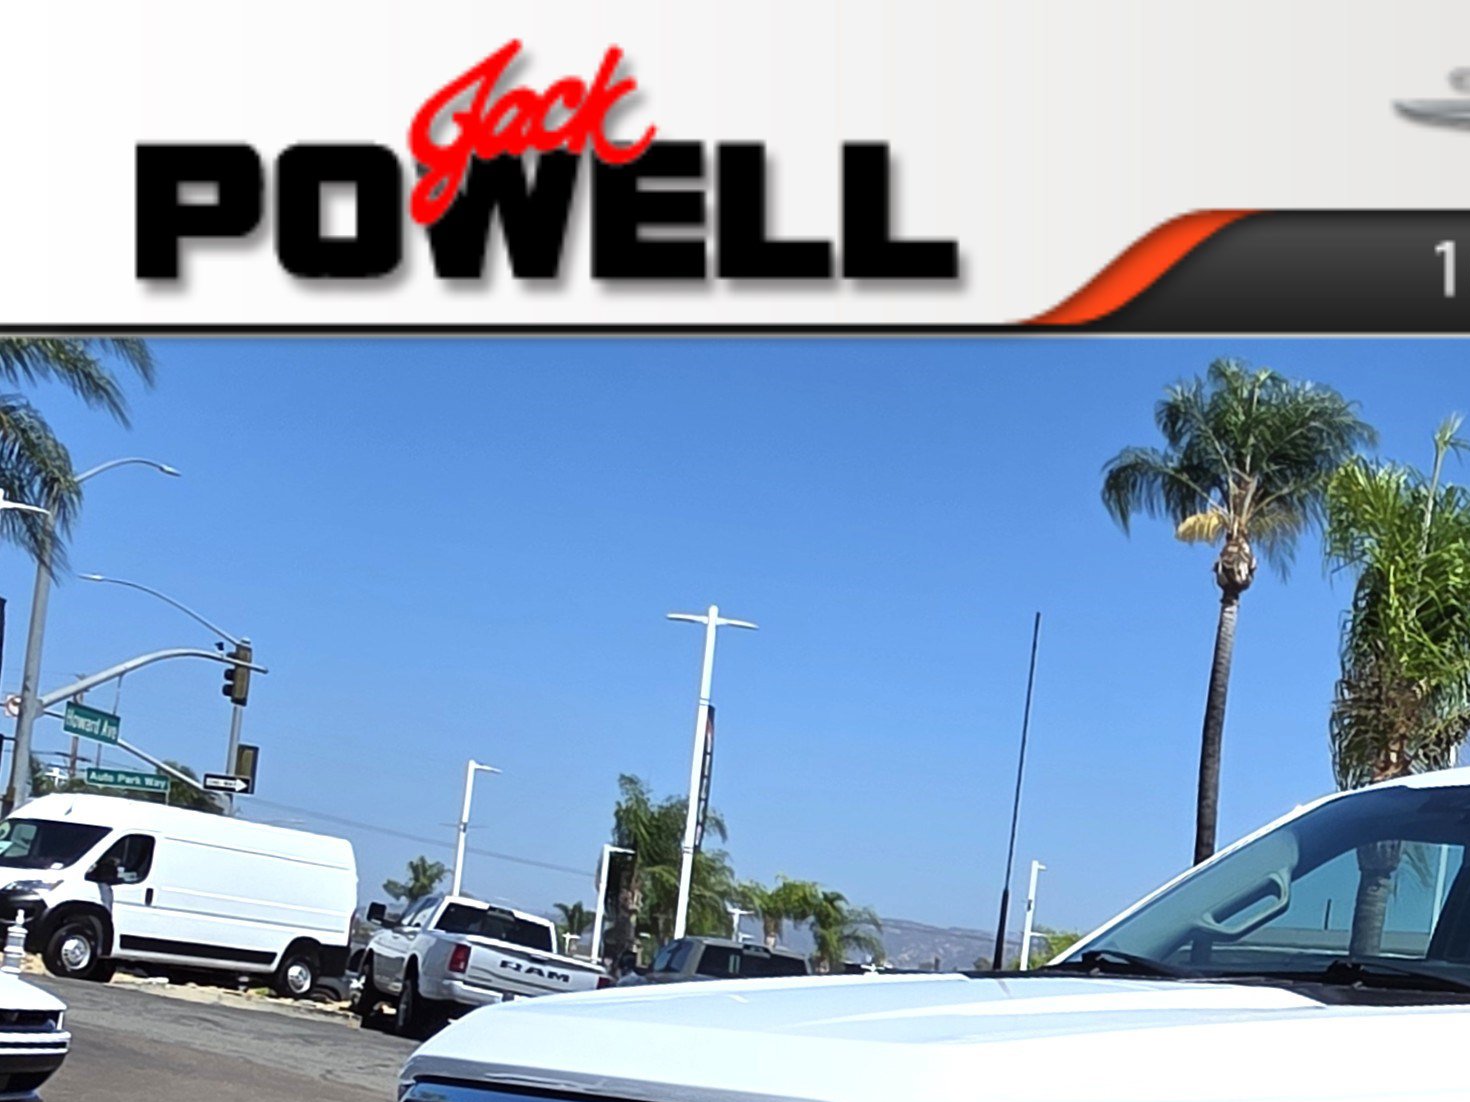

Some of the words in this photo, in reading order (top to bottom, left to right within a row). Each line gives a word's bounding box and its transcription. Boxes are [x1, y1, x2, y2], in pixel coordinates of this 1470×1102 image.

[66, 708, 102, 735] Howard
[101, 718, 118, 740] Ave
[89, 771, 115, 783] Auto
[117, 773, 142, 785] Park
[144, 777, 167, 790] Way
[500, 959, 570, 983] RAM
